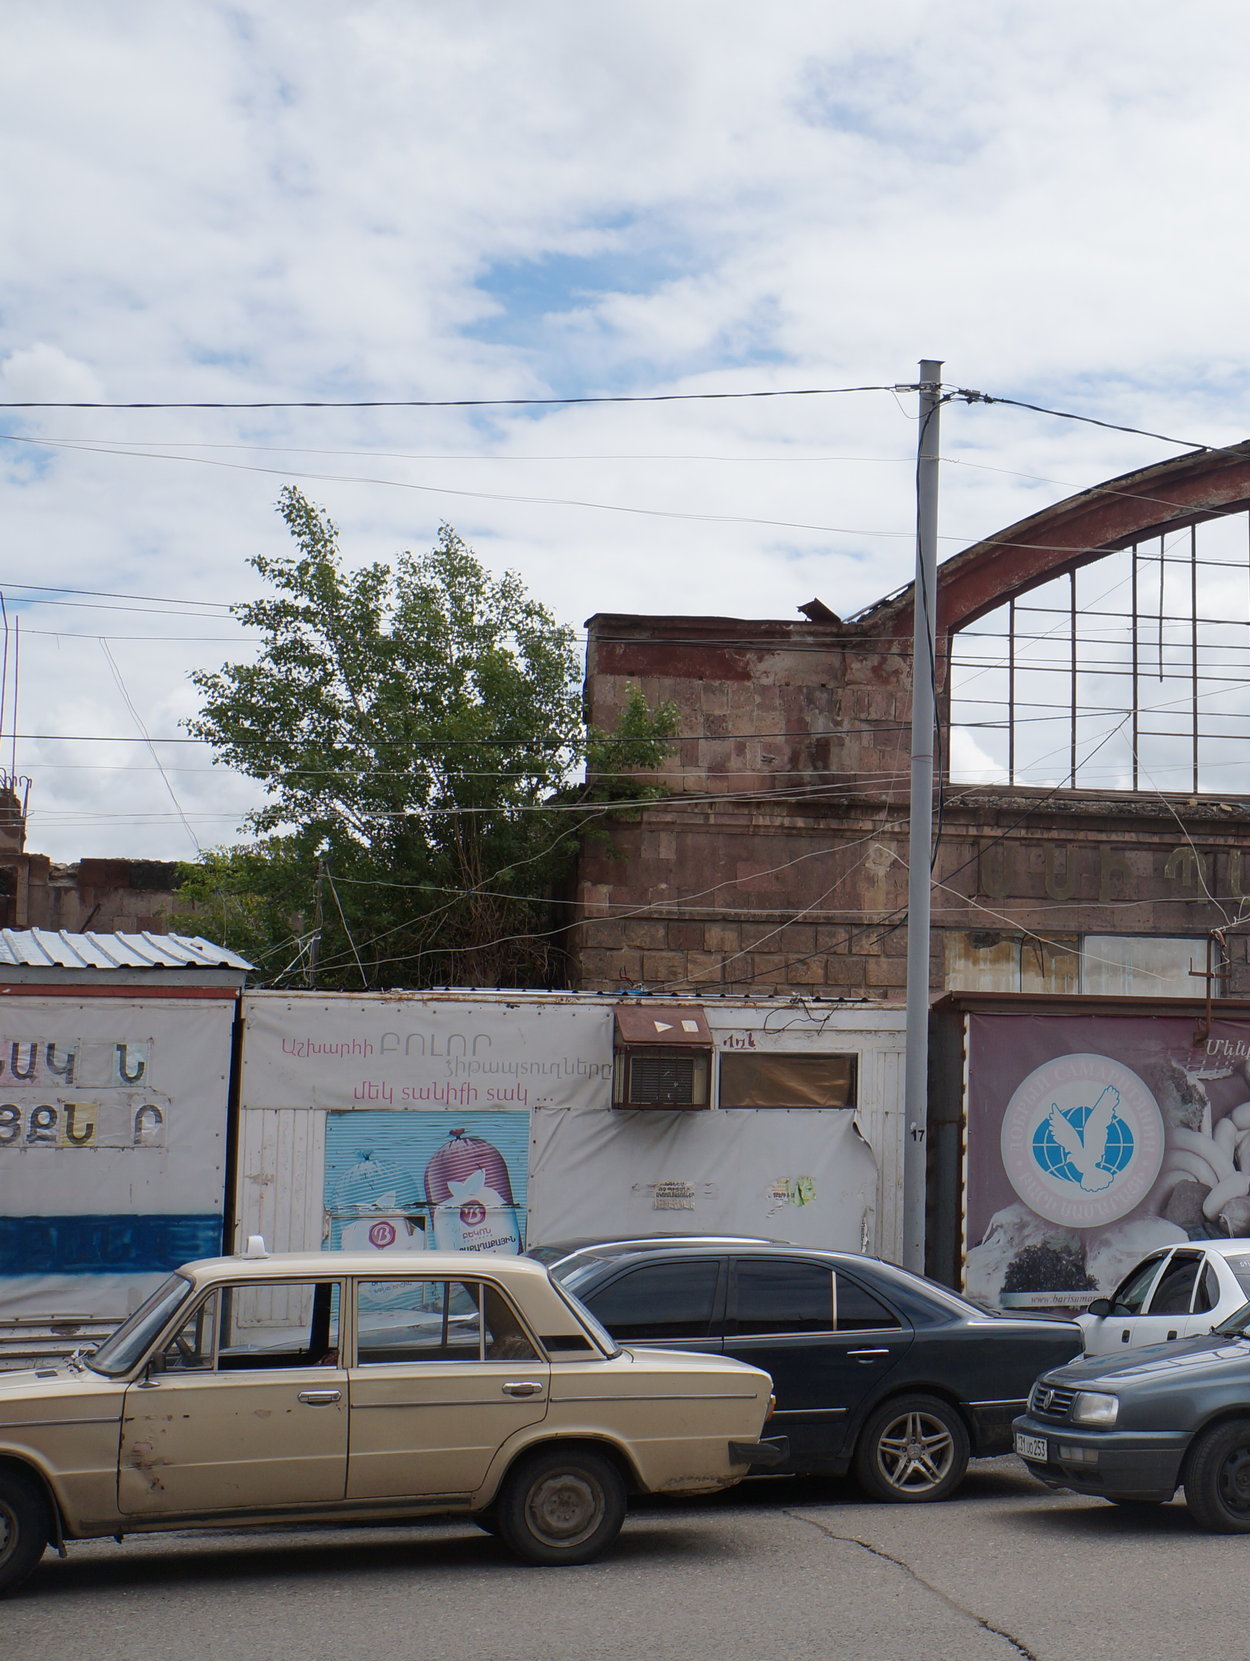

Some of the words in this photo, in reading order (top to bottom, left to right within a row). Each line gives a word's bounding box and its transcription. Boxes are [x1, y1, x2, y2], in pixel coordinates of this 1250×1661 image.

[281, 1038, 374, 1058] Աշխարհի
[379, 1032, 493, 1057] ԲՈԼՈՐ
[0, 1042, 76, 1084] ԱԿ
[353, 1080, 393, 1105] մեկ
[487, 1082, 528, 1105] տակ
[911, 1129, 925, 1142] 17
[462, 1227, 492, 1240] ԲԵԿՈՆ
[1034, 1439, 1046, 1456] 253
